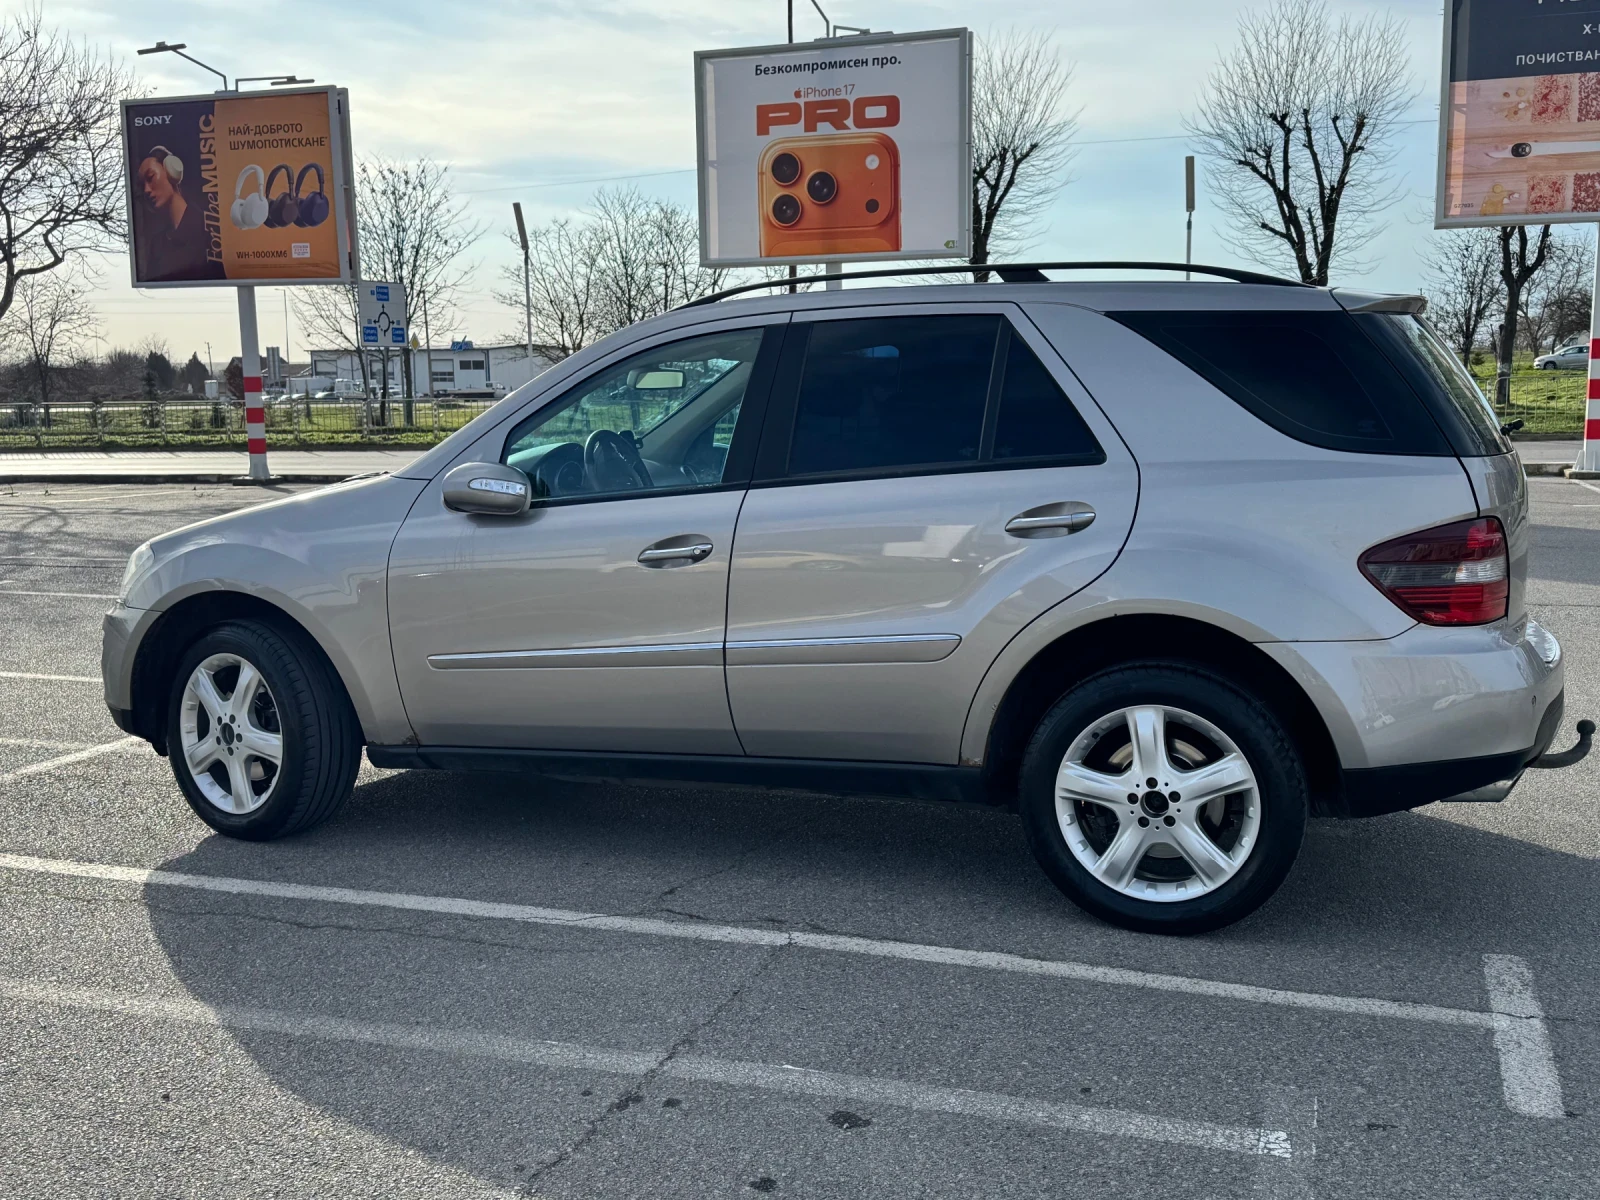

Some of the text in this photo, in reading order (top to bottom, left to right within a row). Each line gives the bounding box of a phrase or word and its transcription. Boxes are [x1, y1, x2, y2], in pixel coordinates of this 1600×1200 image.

[1582, 23, 1600, 35] X-
[1516, 49, 1600, 66] ПОЧИСТВАН
[755, 54, 902, 77] Безкомпромисен про.
[803, 83, 856, 98] iPhone 17
[134, 114, 173, 127] SONY
[756, 95, 901, 136] PRO
[228, 122, 303, 136] НАЙ-ДОБРОТО
[236, 250, 288, 259] WH-1000XM6
